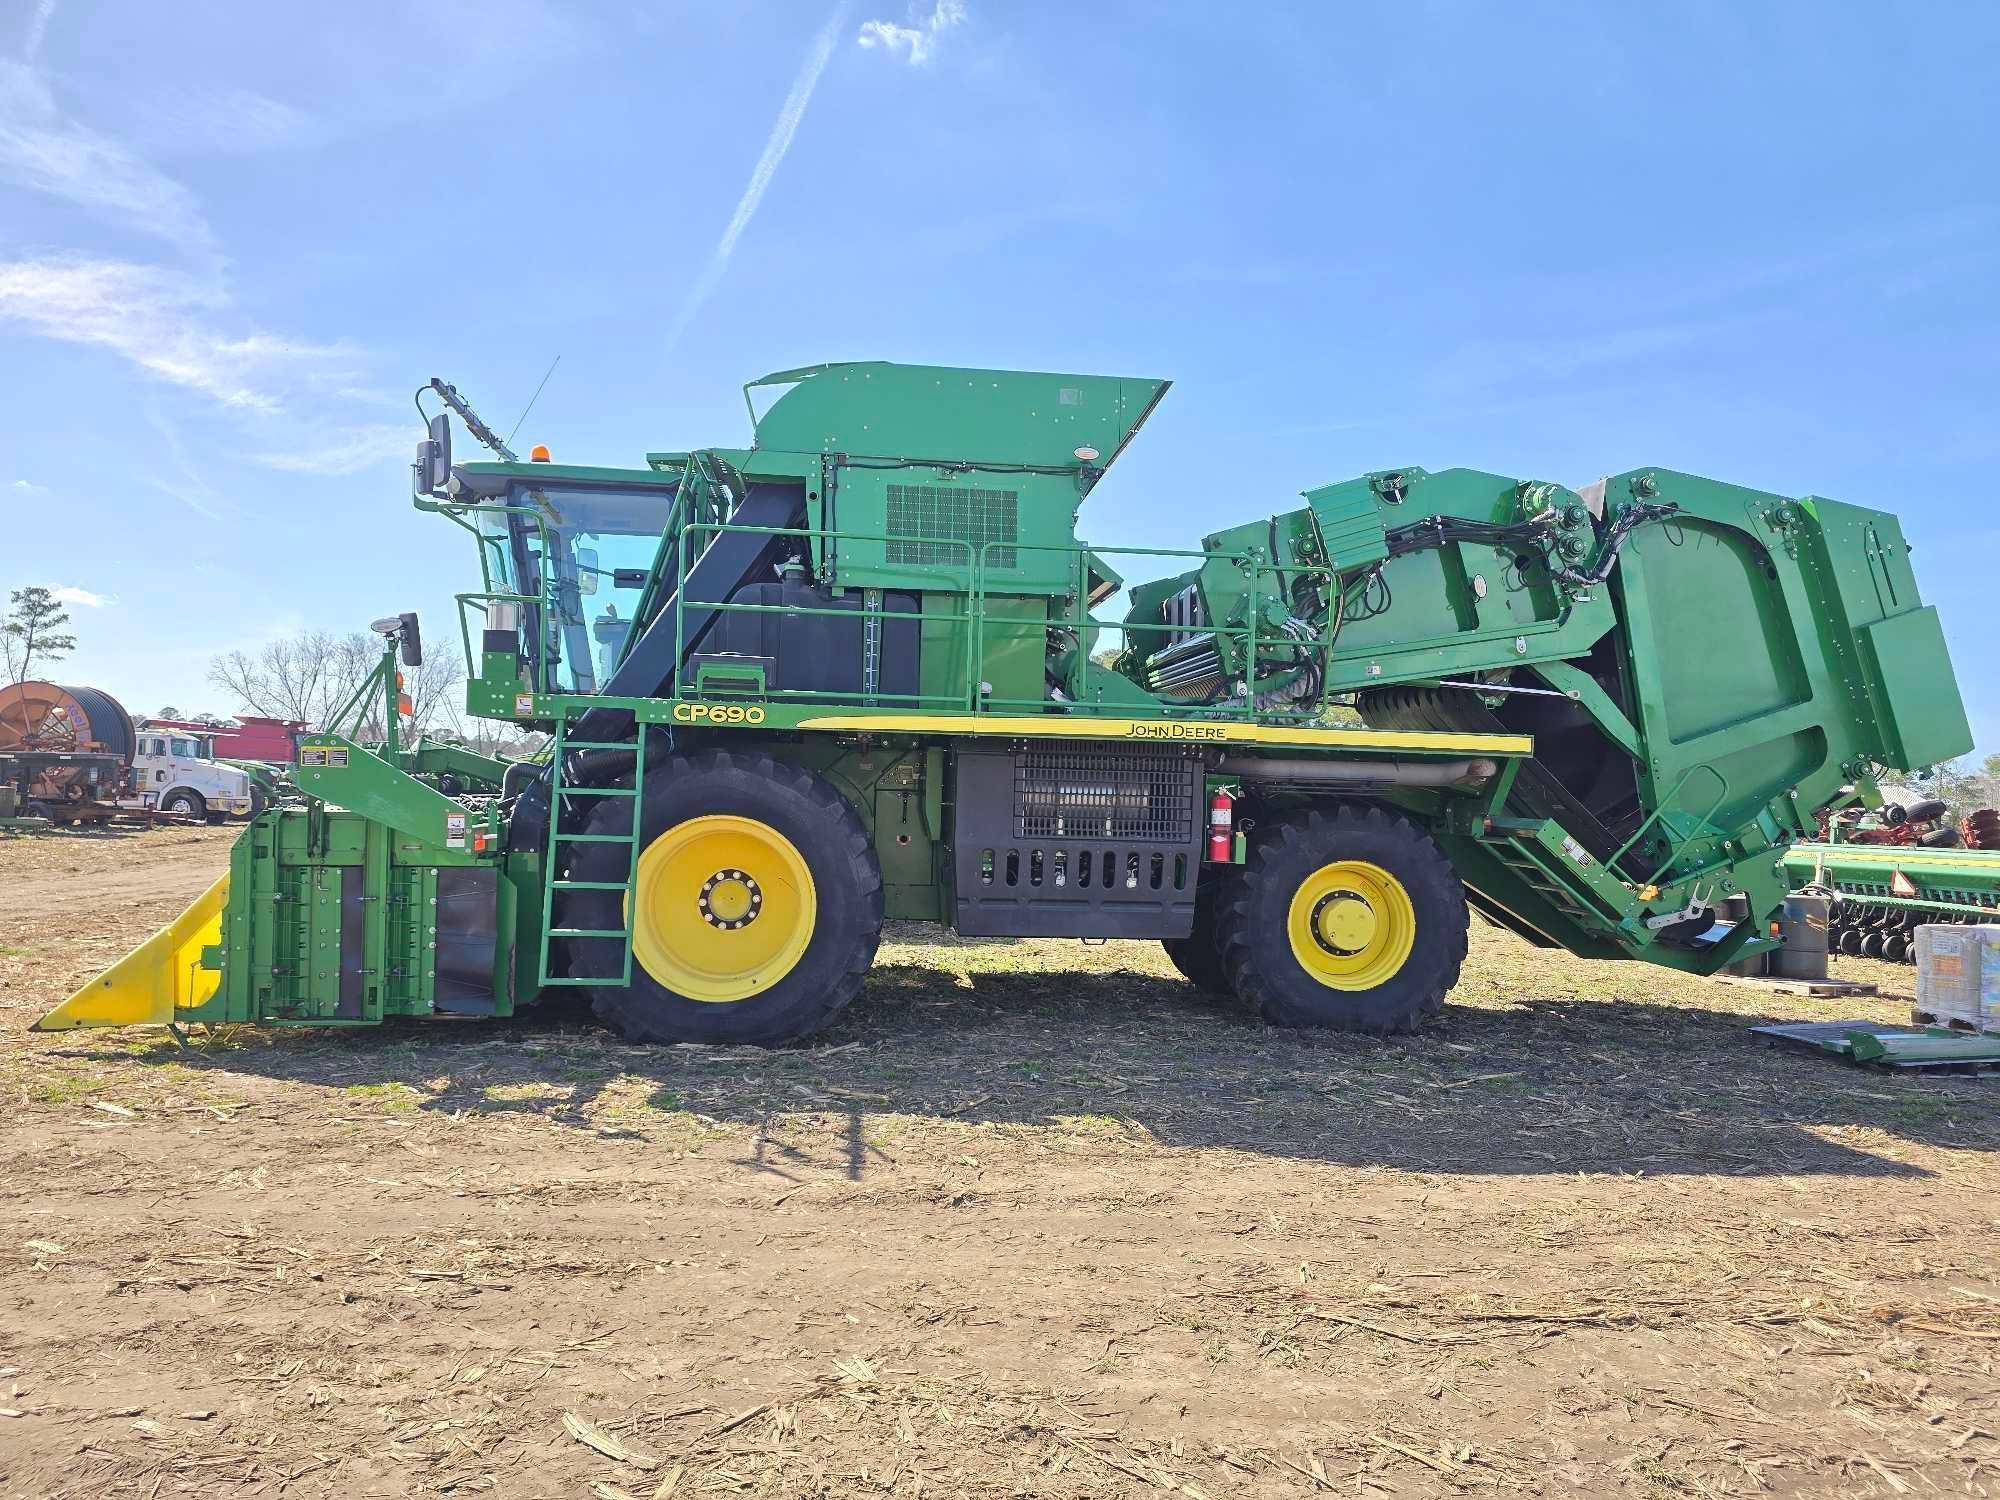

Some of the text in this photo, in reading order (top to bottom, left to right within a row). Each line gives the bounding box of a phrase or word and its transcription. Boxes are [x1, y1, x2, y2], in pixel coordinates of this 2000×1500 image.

[673, 703, 765, 724] CP690
[1126, 723, 1226, 738] JOHN DEERE
